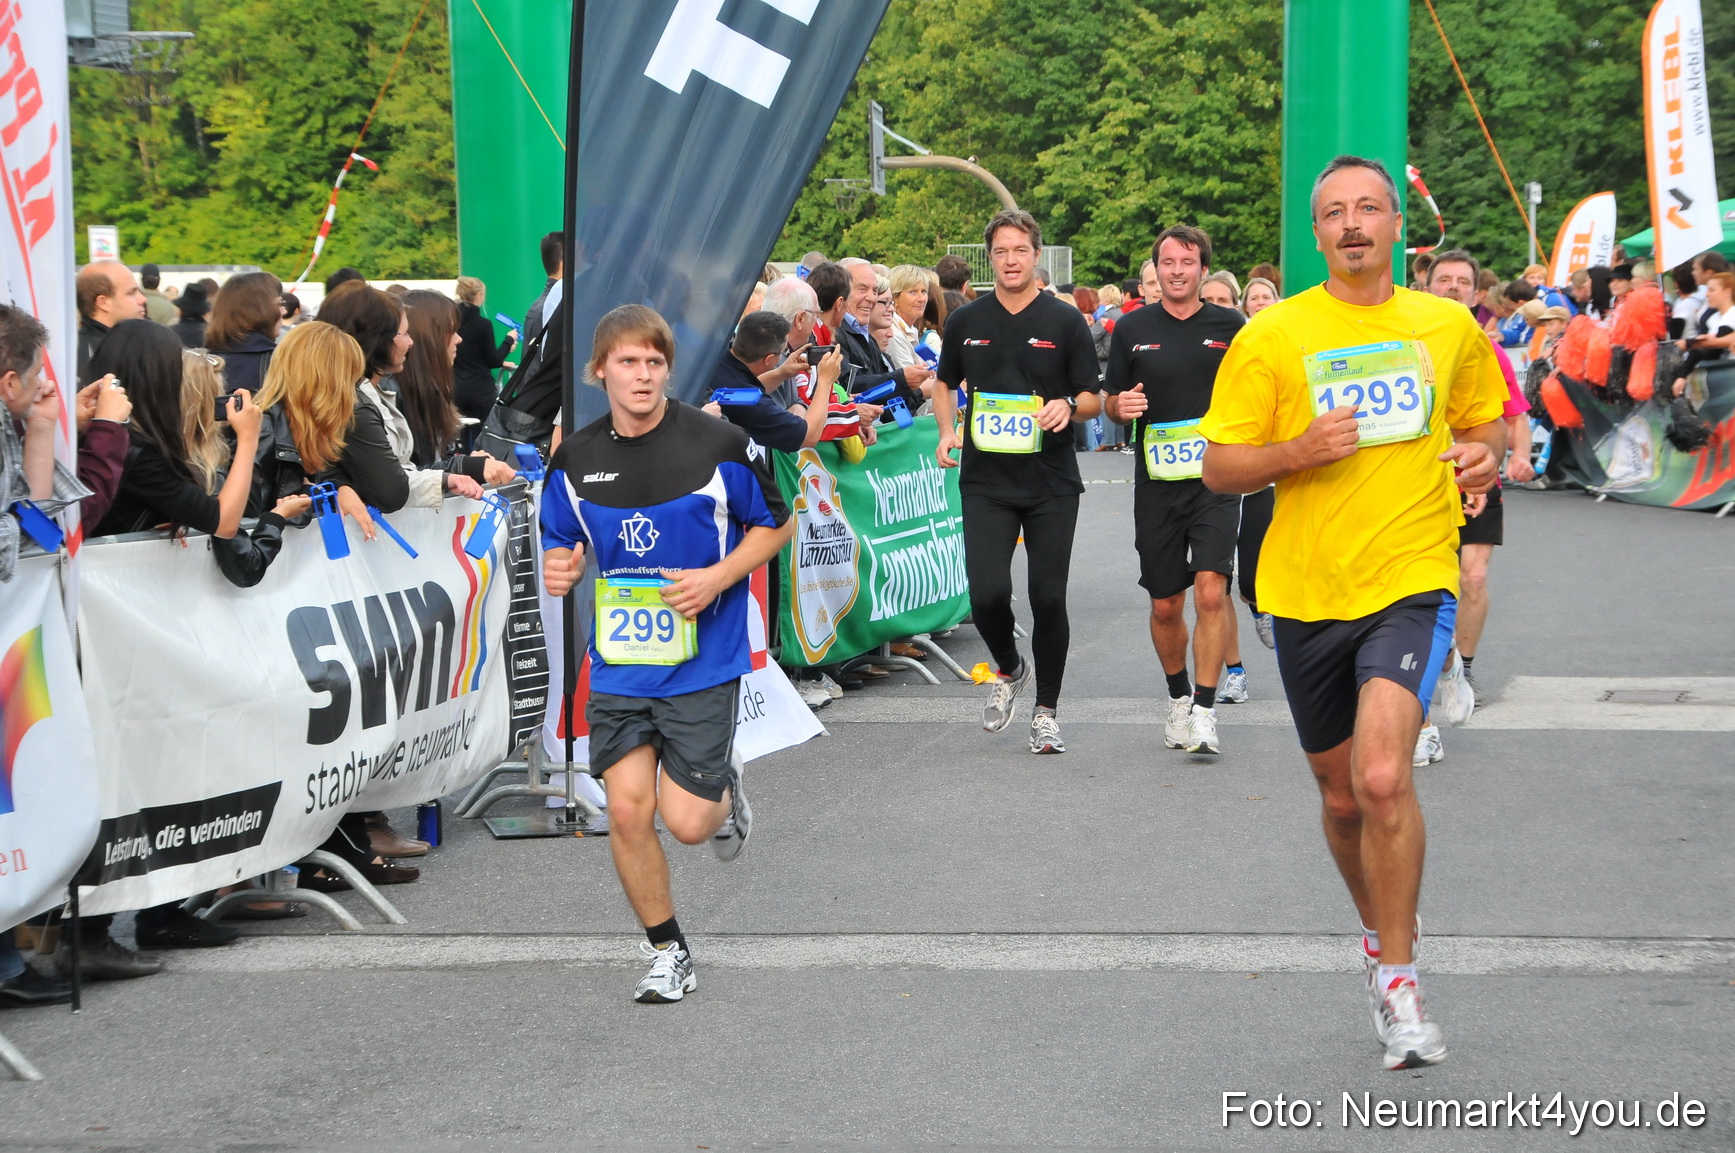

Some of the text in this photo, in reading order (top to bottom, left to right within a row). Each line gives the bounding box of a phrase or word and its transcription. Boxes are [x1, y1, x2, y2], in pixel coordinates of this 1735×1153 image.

[1663, 15, 1685, 176] KLEBL
[1686, 28, 1706, 137] www.klebl.de
[1565, 220, 1596, 286] BL
[1318, 376, 1420, 420] 1293
[975, 413, 1033, 437] 1349
[1149, 440, 1208, 465] 1352
[582, 471, 620, 484] saller
[865, 453, 949, 528] Neumarkter
[805, 518, 847, 541] Neumarkter
[799, 538, 853, 569] Lammsbräu
[608, 608, 675, 643] 299
[623, 643, 649, 652] Daniel
[513, 695, 545, 710] Stadtbusse
[736, 680, 766, 726] .de
[104, 809, 263, 866] Leistung, die verbinden
